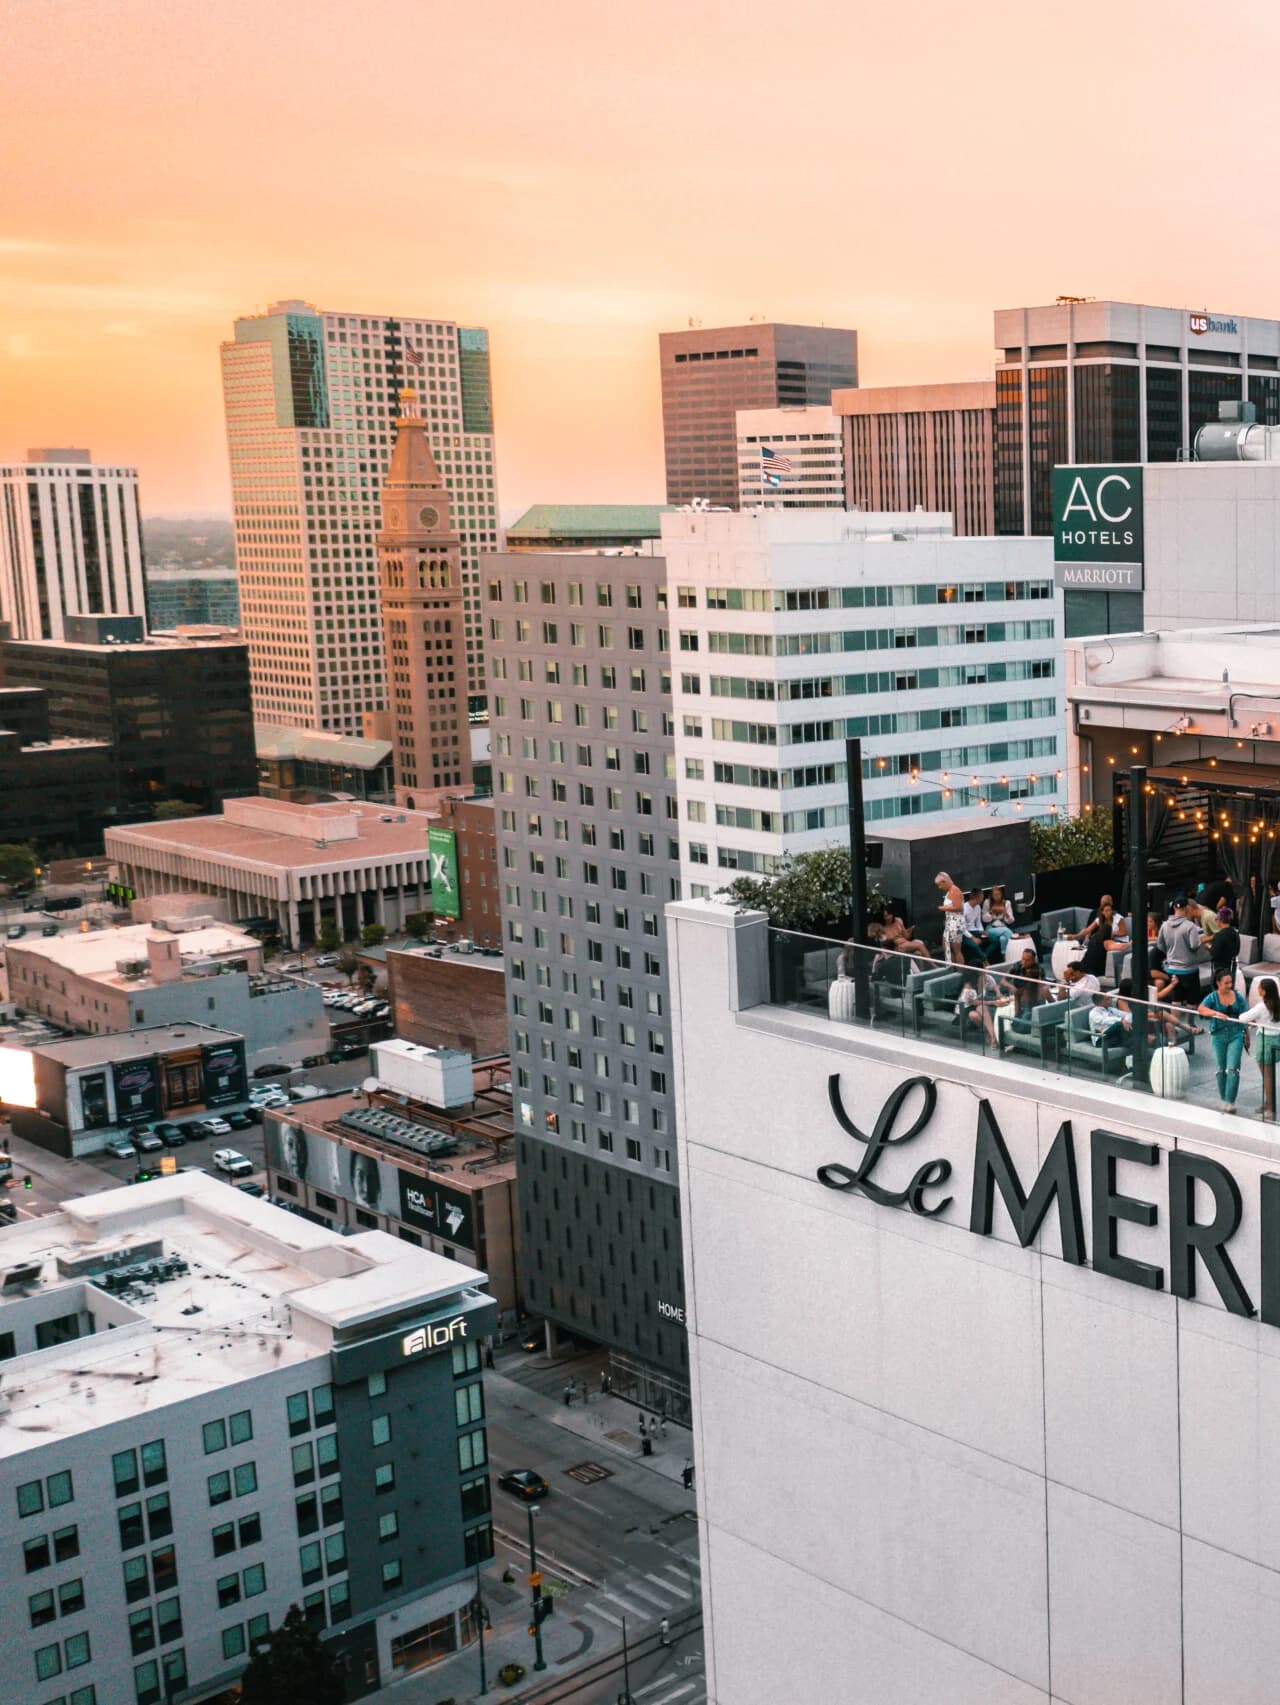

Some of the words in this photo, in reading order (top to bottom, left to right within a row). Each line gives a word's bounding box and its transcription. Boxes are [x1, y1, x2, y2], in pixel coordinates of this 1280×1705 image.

[1062, 475, 1133, 523] AC
[1062, 531, 1134, 545] HOTELS
[1063, 569, 1134, 585] MARRIOTT
[817, 1074, 953, 1216] Le
[406, 1187, 426, 1207] HCA
[658, 1299, 684, 1322] HOME
[403, 1316, 468, 1356] aloft
